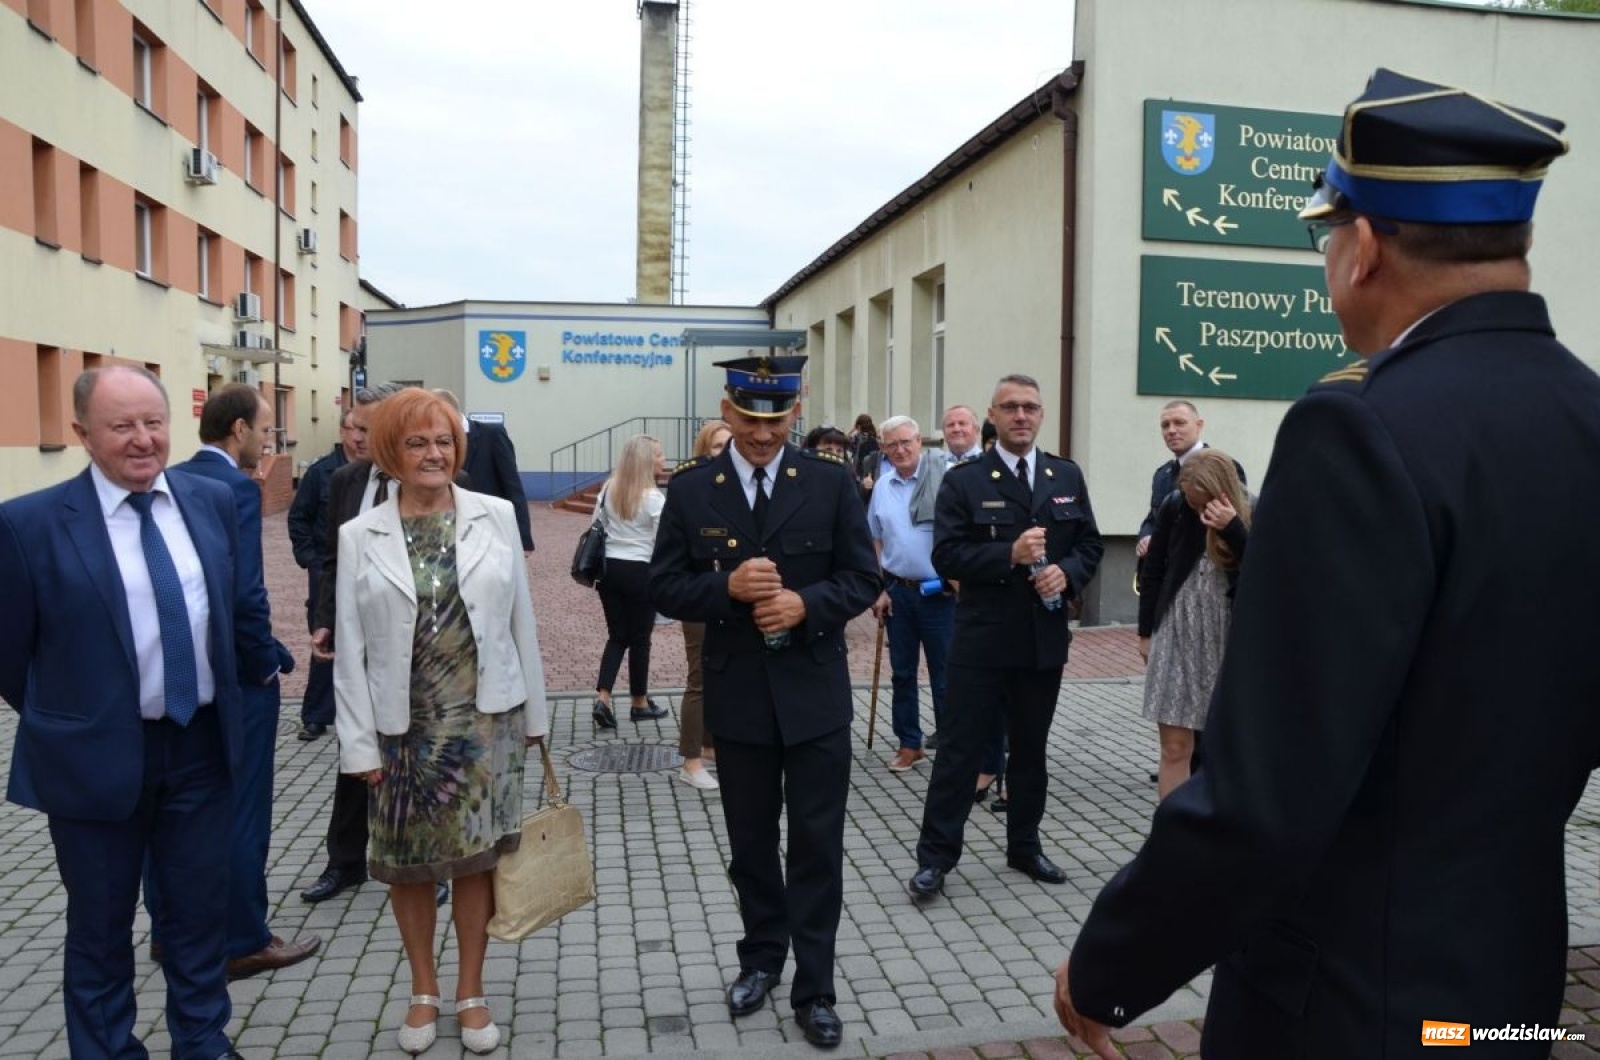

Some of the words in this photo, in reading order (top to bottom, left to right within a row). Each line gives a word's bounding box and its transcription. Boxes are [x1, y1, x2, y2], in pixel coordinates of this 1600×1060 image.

[1239, 124, 1337, 152] Powiatow
[1251, 156, 1325, 182] Centru
[1218, 183, 1309, 211] Konfere
[1176, 281, 1296, 318] Terenowy
[1303, 288, 1336, 314] Pu
[562, 331, 645, 347] Powiatowe
[650, 333, 686, 347] Cen
[1199, 321, 1347, 357] Paszportowy
[562, 350, 673, 368] Konferencyjne
